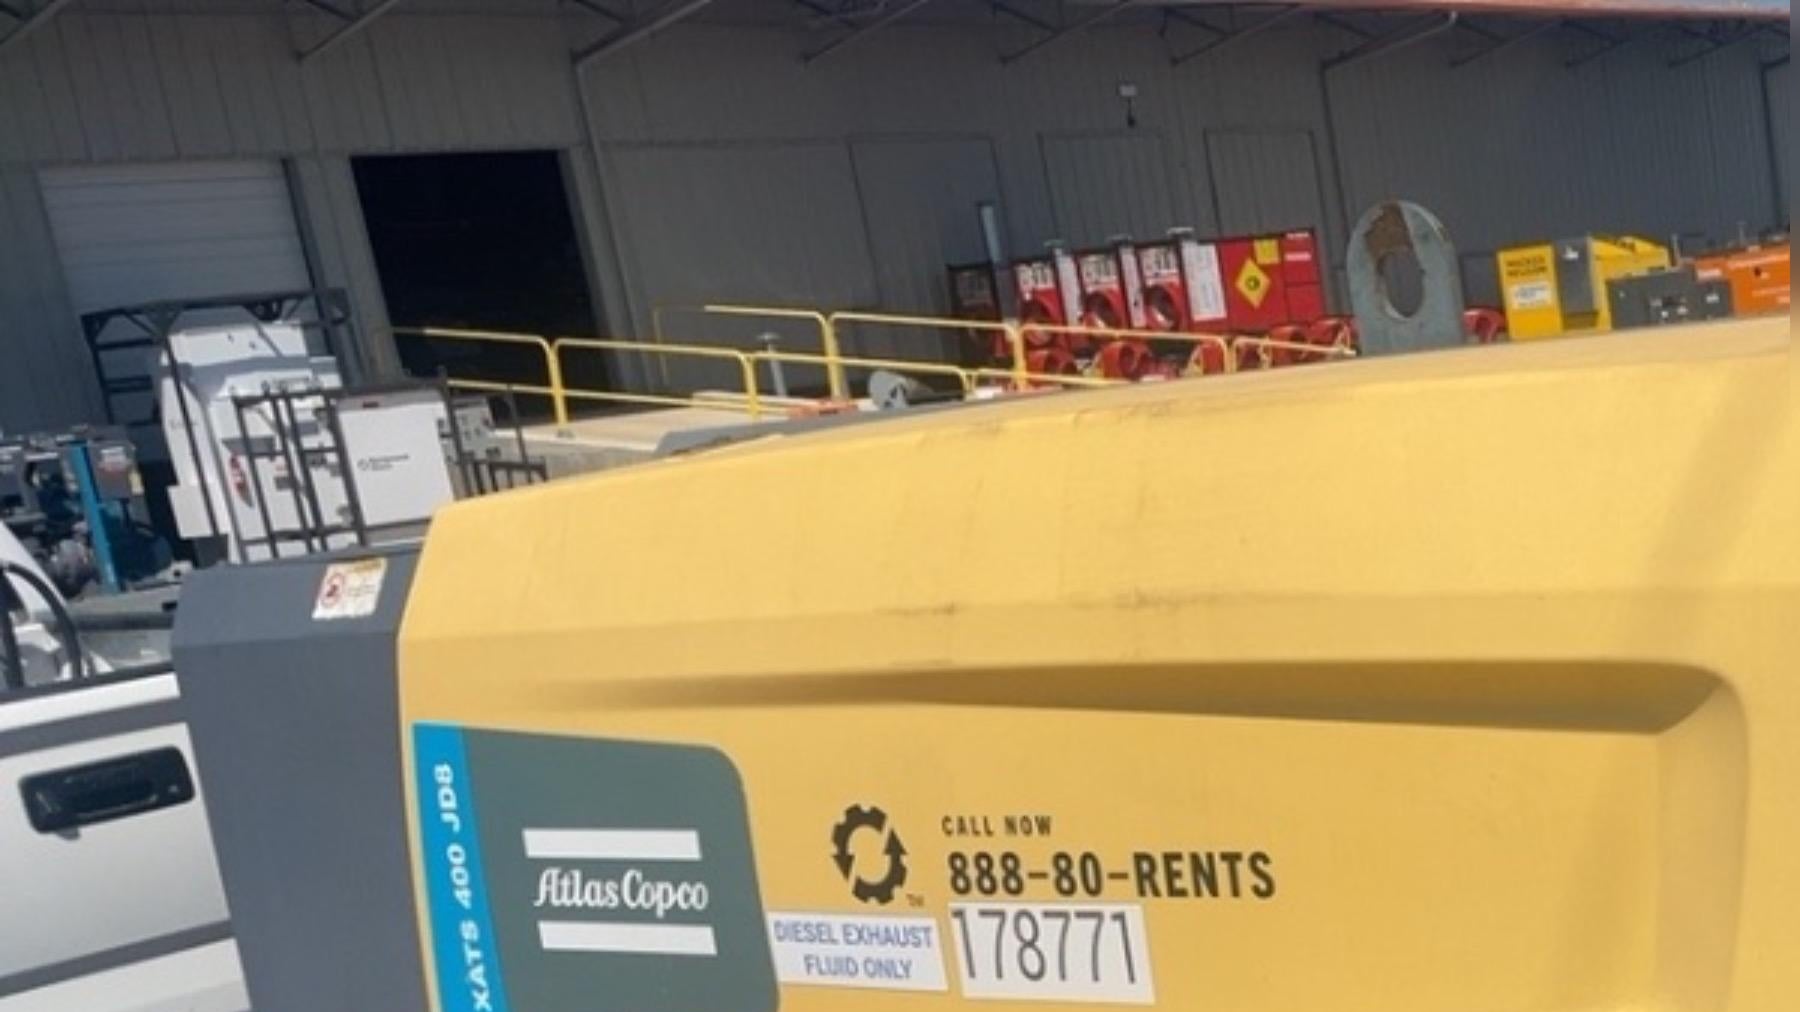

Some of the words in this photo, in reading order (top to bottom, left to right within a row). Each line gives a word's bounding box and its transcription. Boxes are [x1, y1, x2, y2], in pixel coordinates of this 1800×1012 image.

[941, 815, 994, 837] CALL
[1004, 815, 1051, 836] NOW
[446, 842, 472, 909] 400
[533, 866, 619, 909] Atlas
[621, 868, 709, 919] Copco
[948, 851, 1276, 898] 888-80-RENTS
[773, 919, 839, 945] DIESEL
[841, 923, 933, 948] EXHAUST
[951, 908, 1136, 984] 178771
[803, 954, 859, 977] FLUID
[863, 956, 913, 980] ONLY
